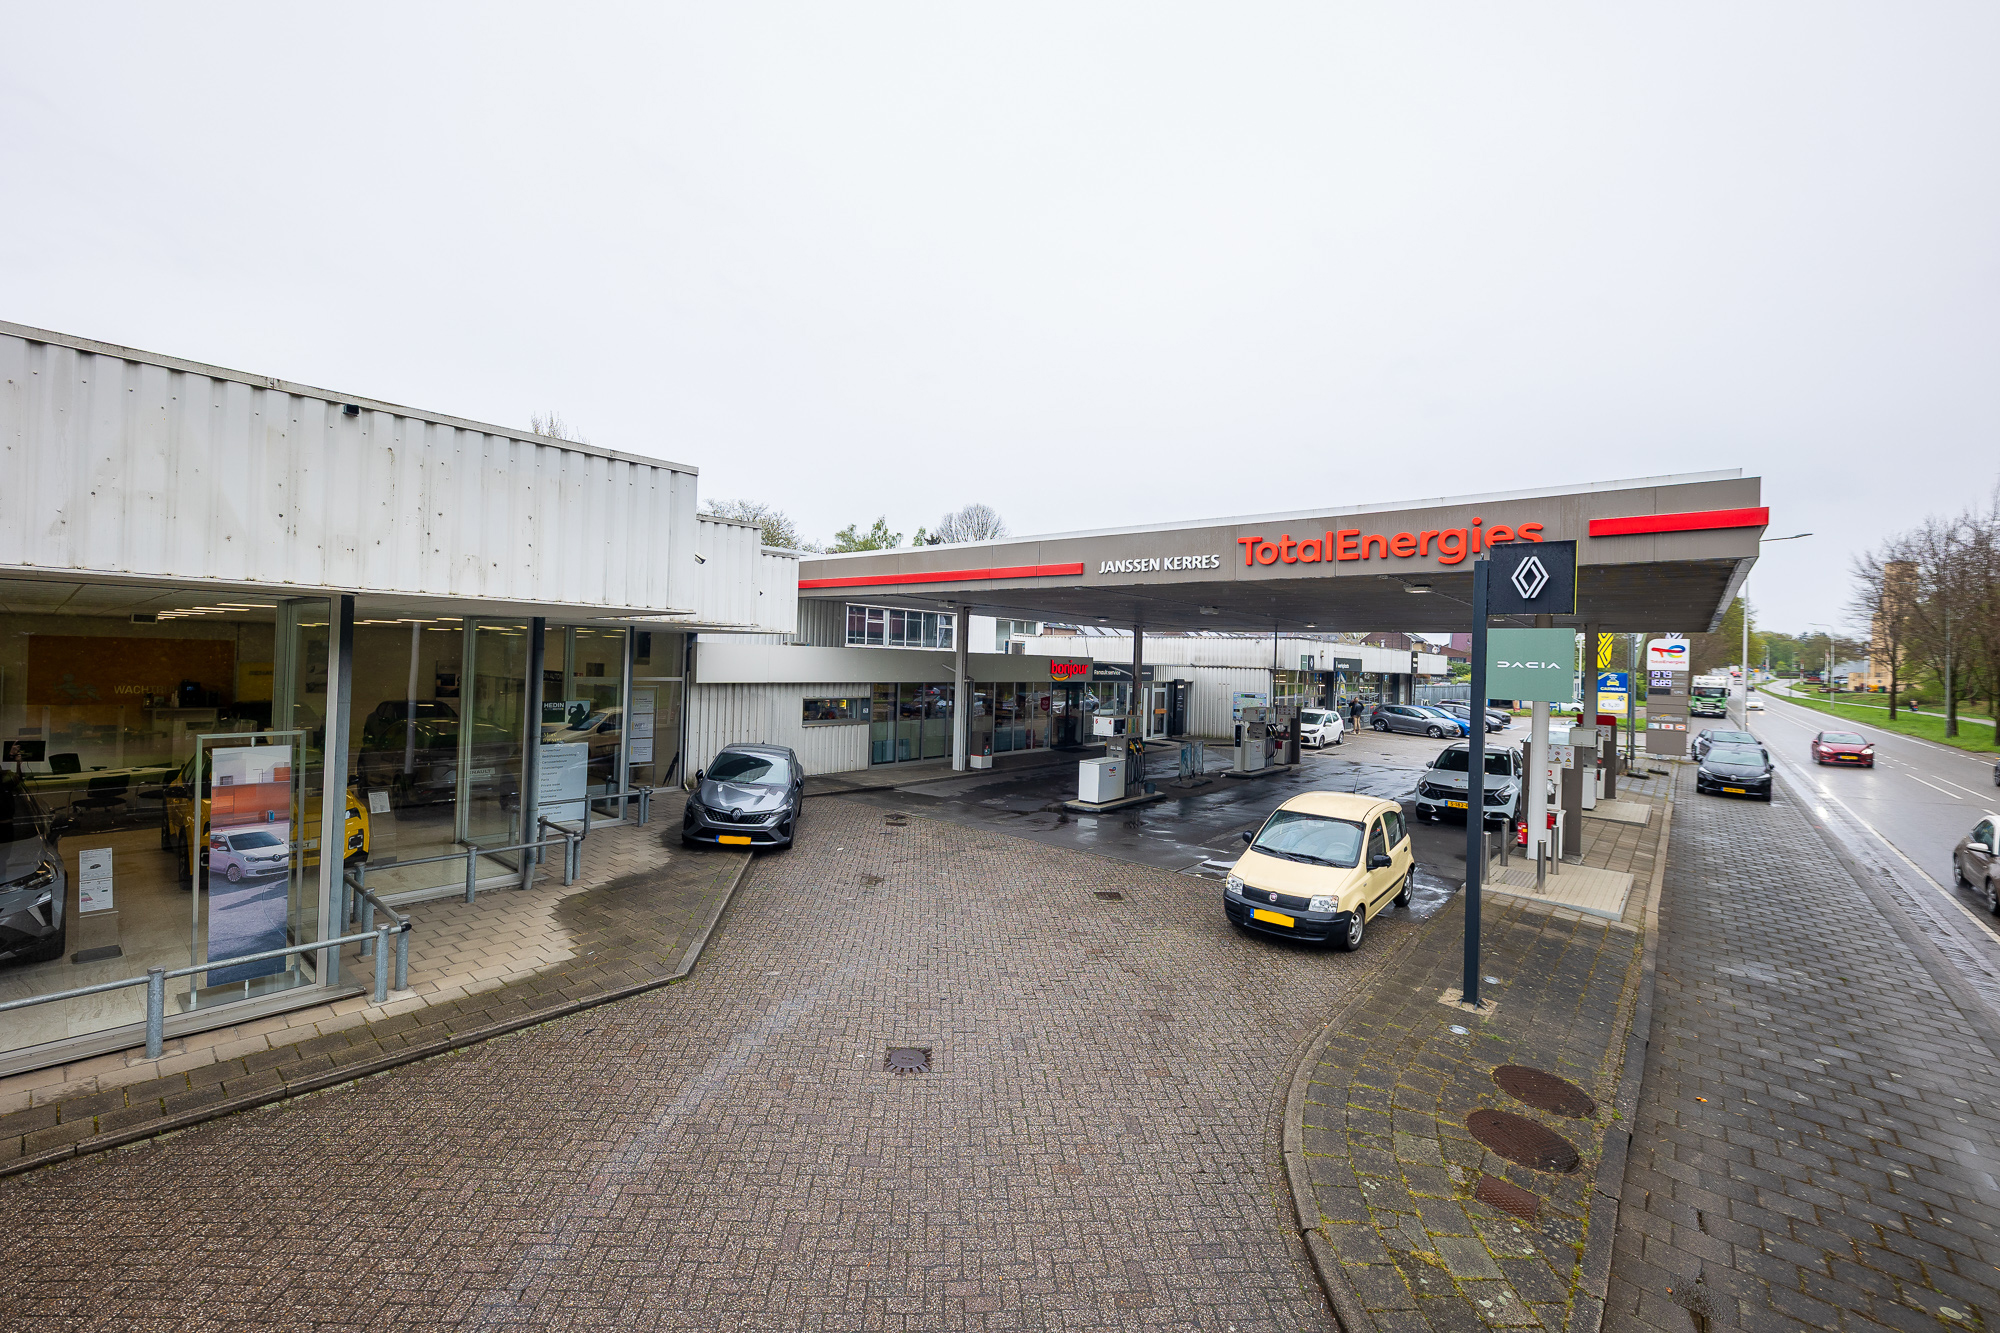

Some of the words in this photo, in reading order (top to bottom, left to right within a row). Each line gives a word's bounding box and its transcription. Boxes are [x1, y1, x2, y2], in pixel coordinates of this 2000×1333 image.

[1237, 517, 1544, 565] TotalEnergies
[1099, 558, 1161, 575] JANSSEN
[1163, 554, 1220, 571] KERRES
[1051, 659, 1089, 678] bonjour
[1497, 661, 1560, 669] DACIA
